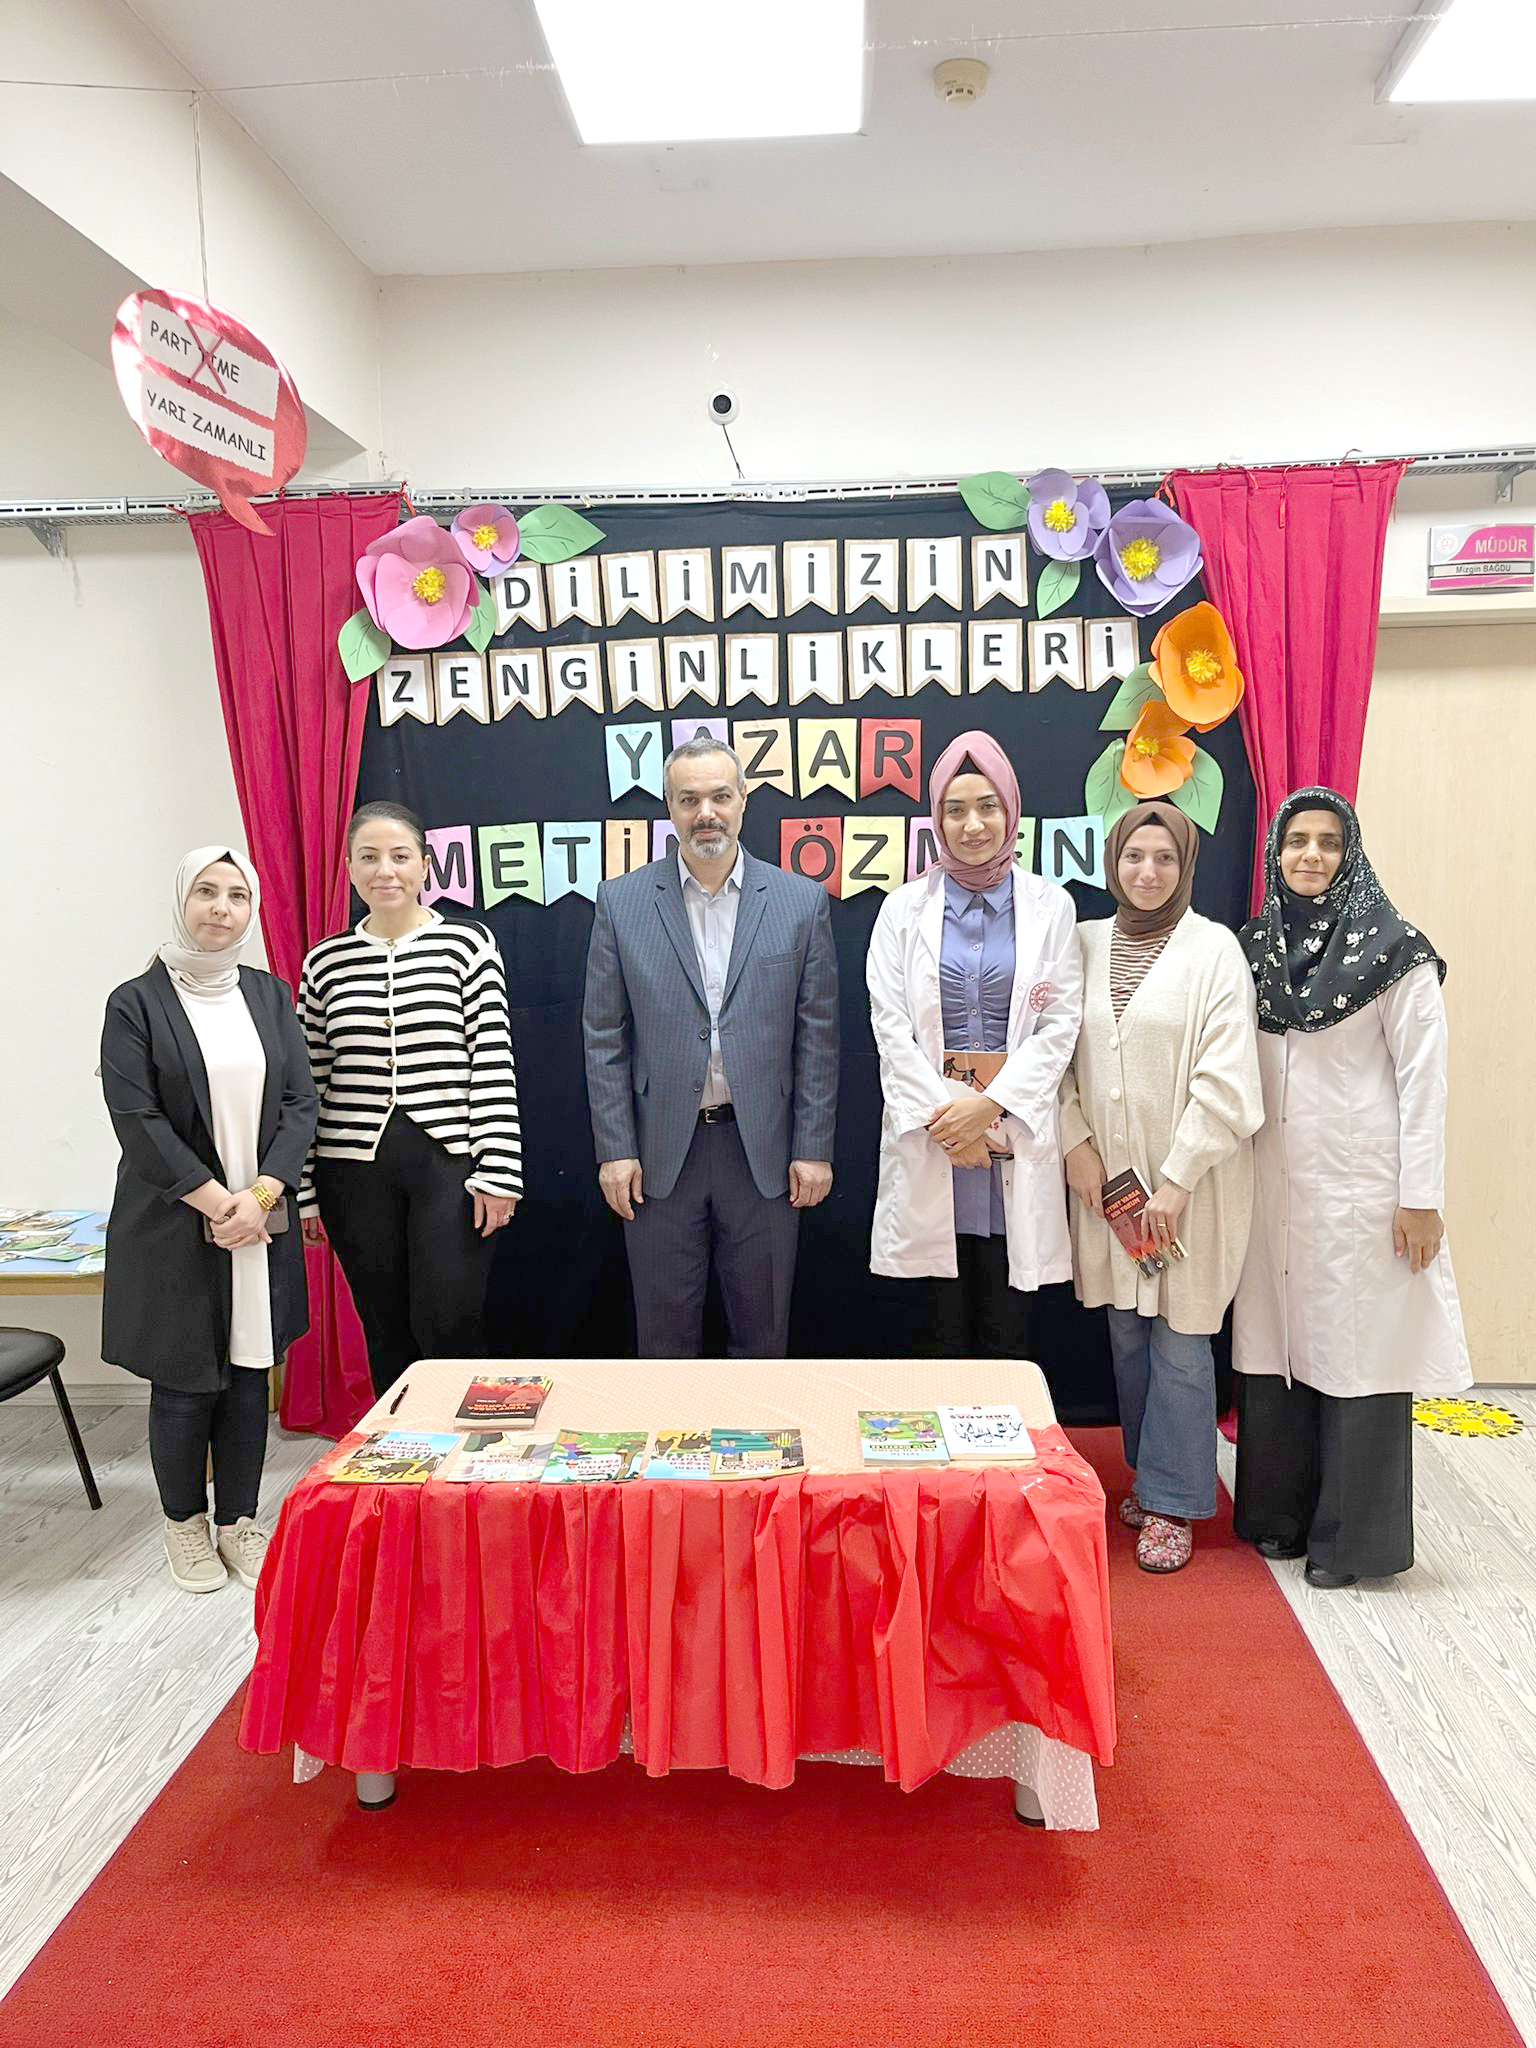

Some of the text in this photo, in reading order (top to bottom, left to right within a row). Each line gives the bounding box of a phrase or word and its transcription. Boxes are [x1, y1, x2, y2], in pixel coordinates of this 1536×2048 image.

[150, 320, 240, 383] PART IME
[146, 388, 266, 461] YARI ZAMANLI
[1455, 565, 1481, 574] Mizgin
[1475, 535, 1528, 554] MÜDÜR
[503, 543, 1012, 610] DİLİMİZİN
[389, 625, 1114, 703] ZENGİNLİKLERİ
[790, 823, 1095, 883] ÖZN
